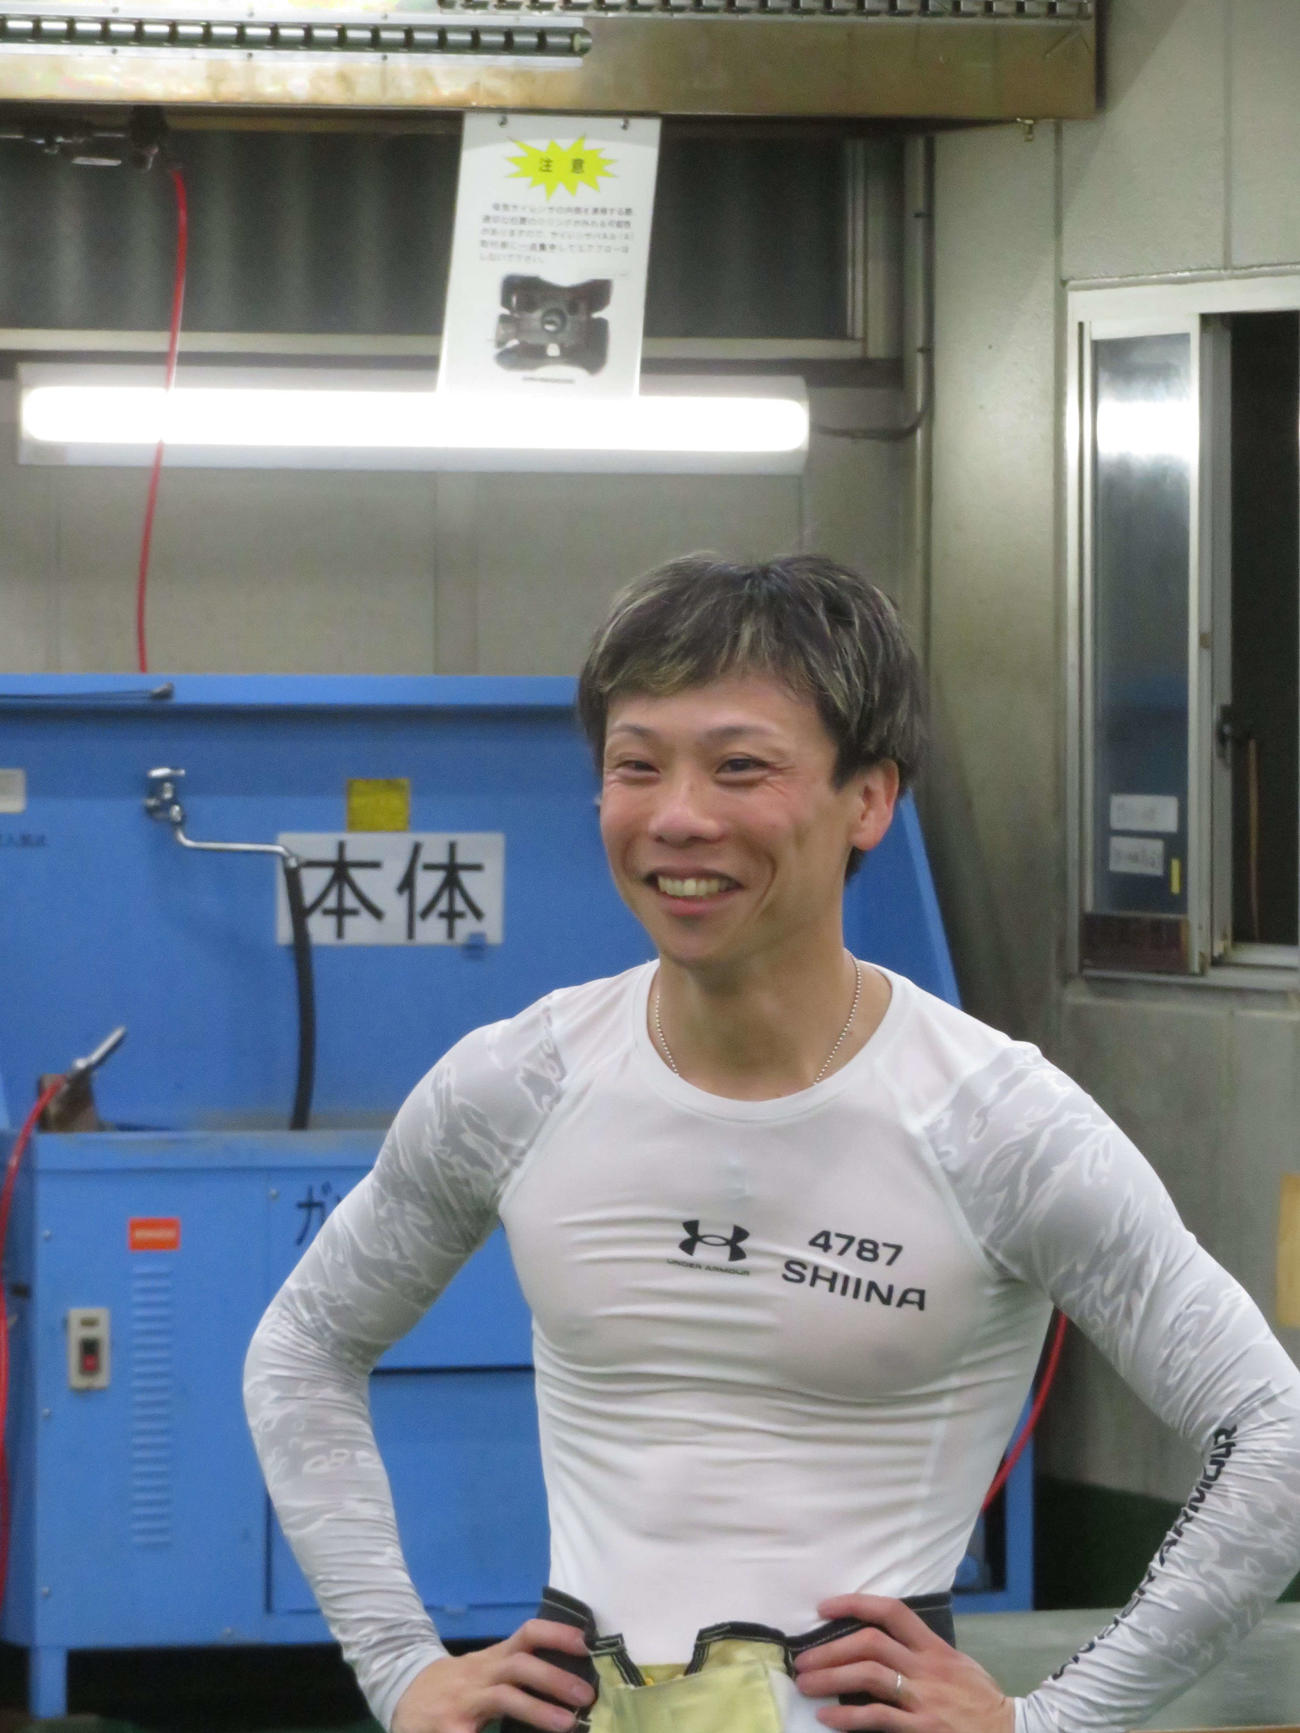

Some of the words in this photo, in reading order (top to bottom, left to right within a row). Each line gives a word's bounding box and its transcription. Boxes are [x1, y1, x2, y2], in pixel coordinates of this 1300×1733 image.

[301, 840, 484, 940] 本体
[296, 1181, 342, 1246] ガ
[666, 1258, 702, 1270] UNDER
[704, 1265, 751, 1276] ARMOUR
[808, 1230, 904, 1266] 4787
[781, 1260, 926, 1311] SHIINA
